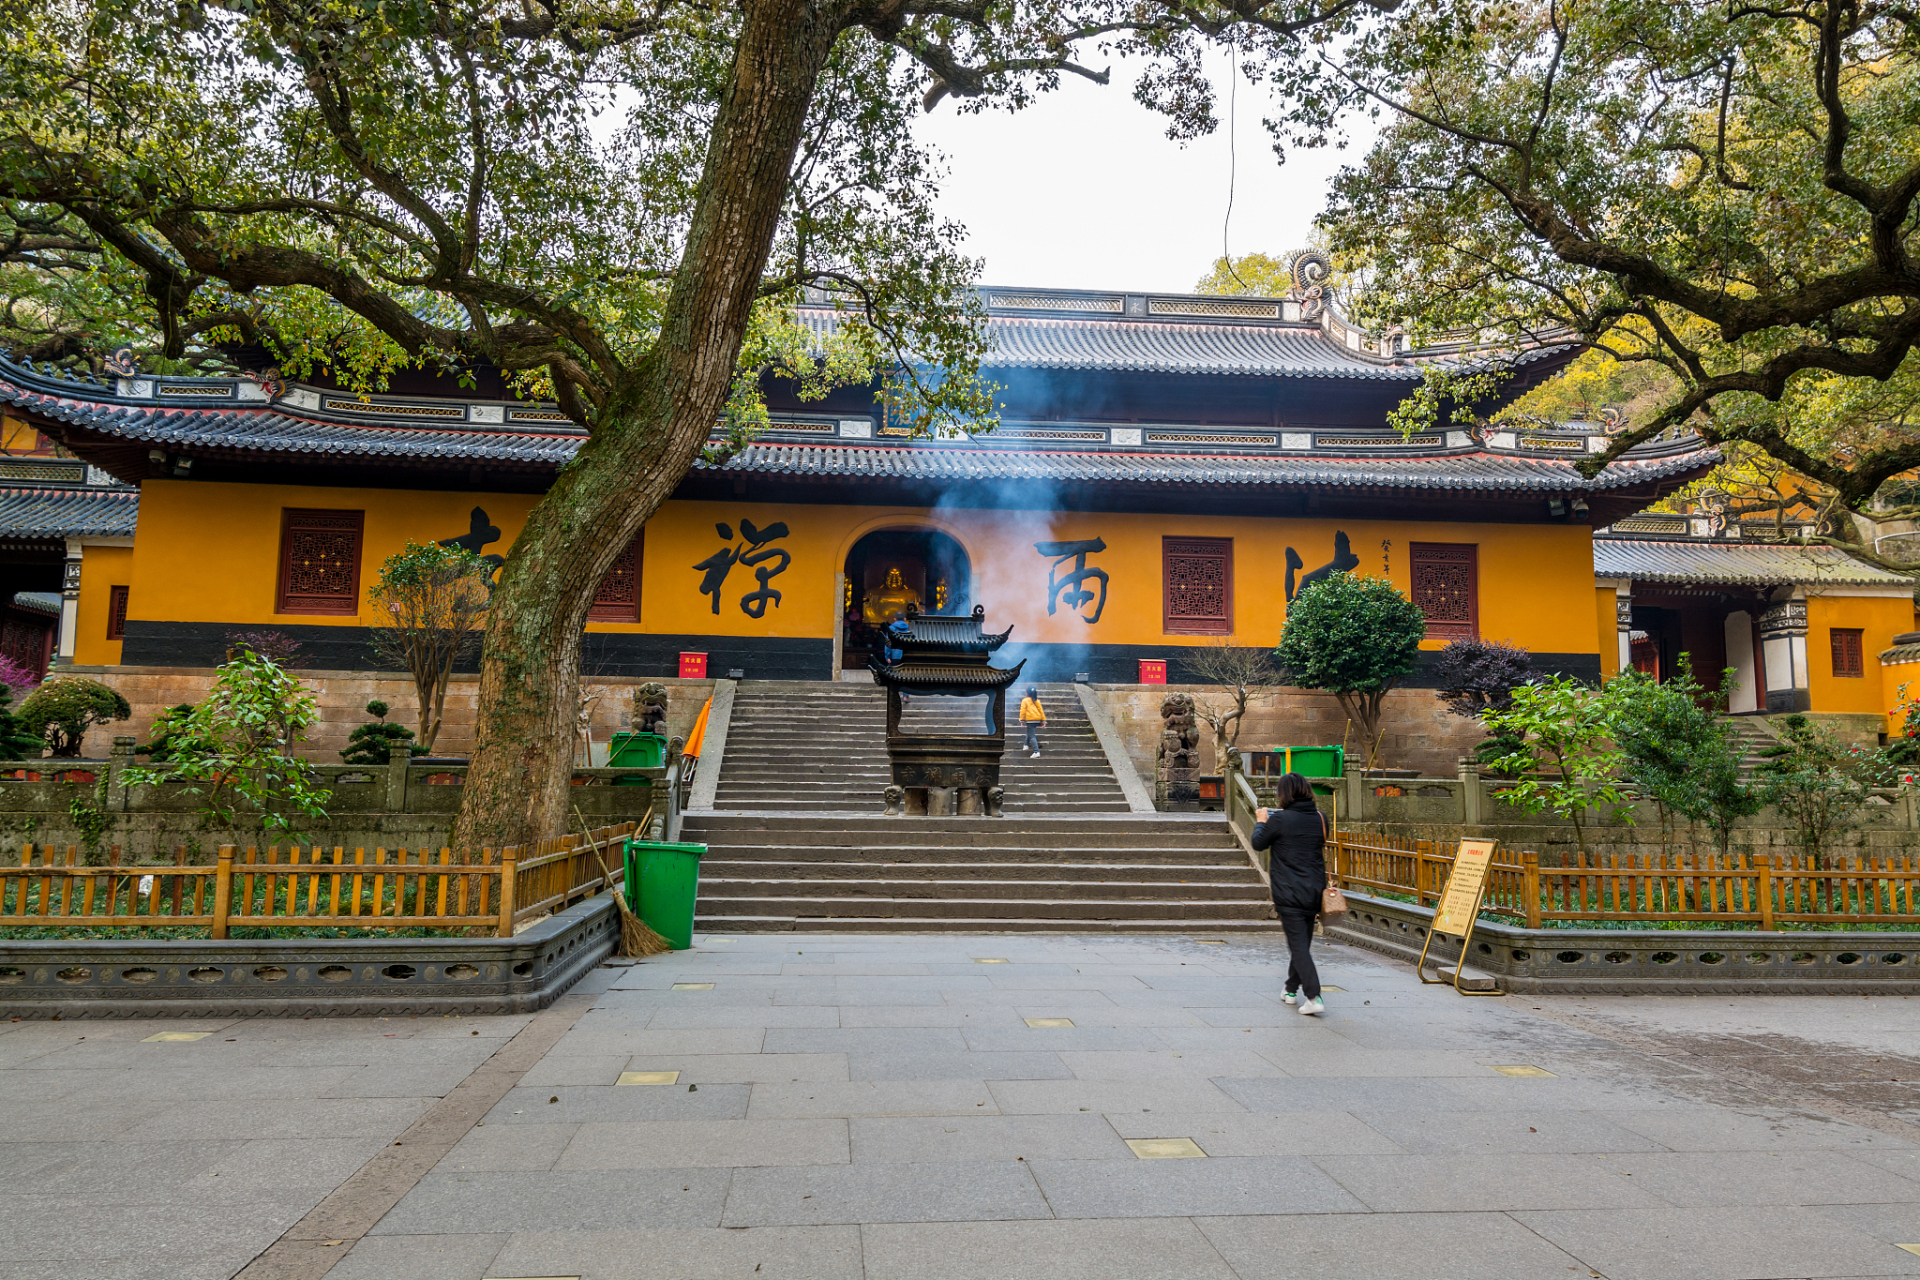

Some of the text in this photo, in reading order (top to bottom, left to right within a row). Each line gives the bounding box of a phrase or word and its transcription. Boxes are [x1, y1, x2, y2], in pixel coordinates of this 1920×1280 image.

[1033, 536, 1109, 624] 雨
[1381, 539, 1392, 575] 癸亥年
